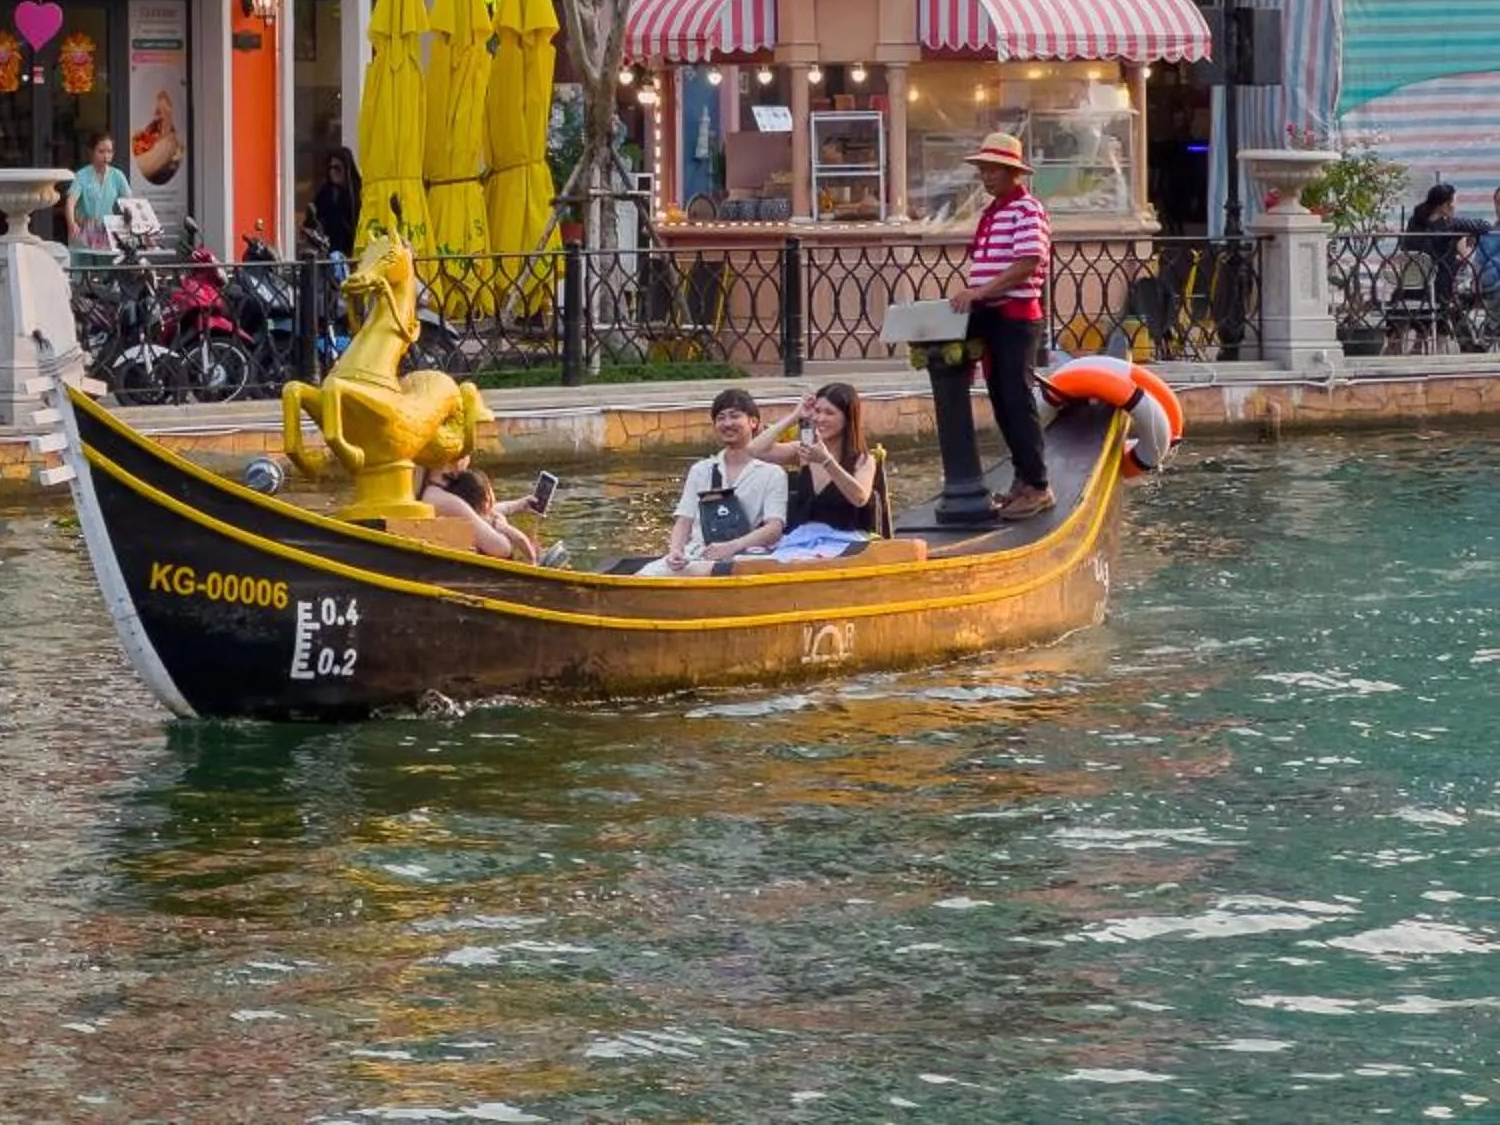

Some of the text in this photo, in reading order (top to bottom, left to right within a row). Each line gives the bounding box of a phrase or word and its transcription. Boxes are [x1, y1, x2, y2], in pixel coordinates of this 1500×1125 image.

[150, 562, 289, 610] KG-00006
[321, 597, 360, 626] 0.4
[317, 647, 357, 676] 0.2
